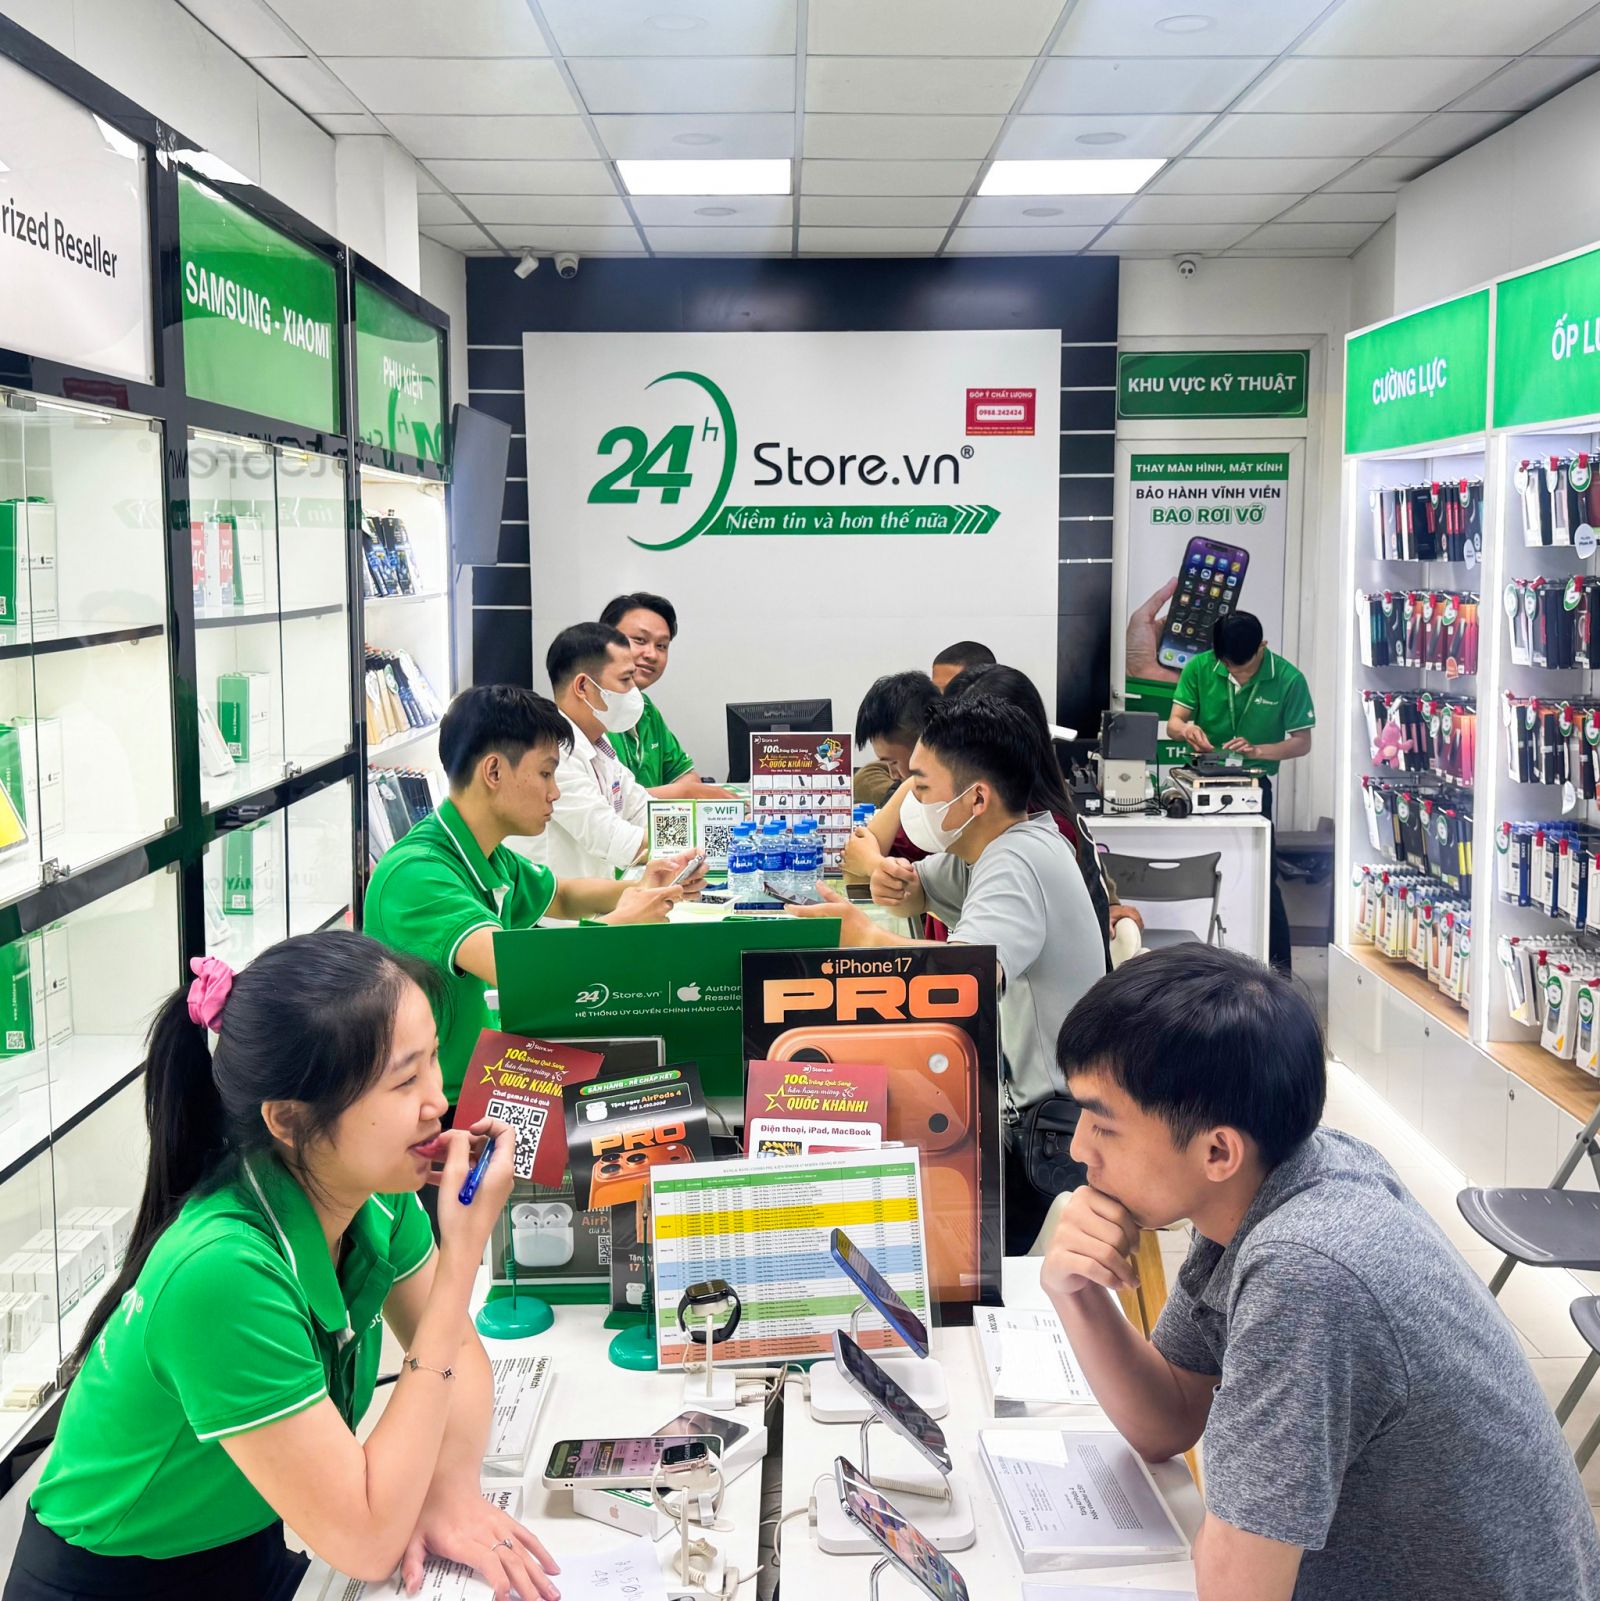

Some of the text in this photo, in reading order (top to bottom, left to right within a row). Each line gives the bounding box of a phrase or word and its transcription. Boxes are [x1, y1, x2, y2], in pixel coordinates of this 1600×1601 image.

[54, 218, 118, 278] Reseller
[185, 260, 271, 336] SAMSUNG
[283, 305, 330, 360] XIAOMI
[1552, 313, 1579, 361] ỐP
[383, 355, 423, 406] PHỤ KIỆN
[1128, 372, 1296, 395] KHU VỰC KỸ THUẬT
[1372, 357, 1447, 405] CƯỜNG LỰC
[1136, 461, 1283, 474] THAY MÀN HÌNH, MẶT KÍNH
[1136, 485, 1164, 499] BẢO
[1168, 485, 1208, 499] HÀNH
[1211, 485, 1245, 499] VĨNH
[726, 507, 948, 531] Niềm tin và hơn thế nữa
[1152, 503, 1265, 524] BAO RƠI VỠ
[835, 957, 912, 975] iPhone 17
[763, 973, 979, 1023] PRO
[500, 1072, 529, 1089] QUỐC
[641, 1092, 675, 1103] AirPods
[787, 1095, 868, 1113] QUỐC KHÁNH!
[591, 1121, 687, 1157] PRO
[761, 1124, 780, 1133] Điện
[808, 1126, 829, 1135] iPad,
[831, 1127, 871, 1136] MacBook
